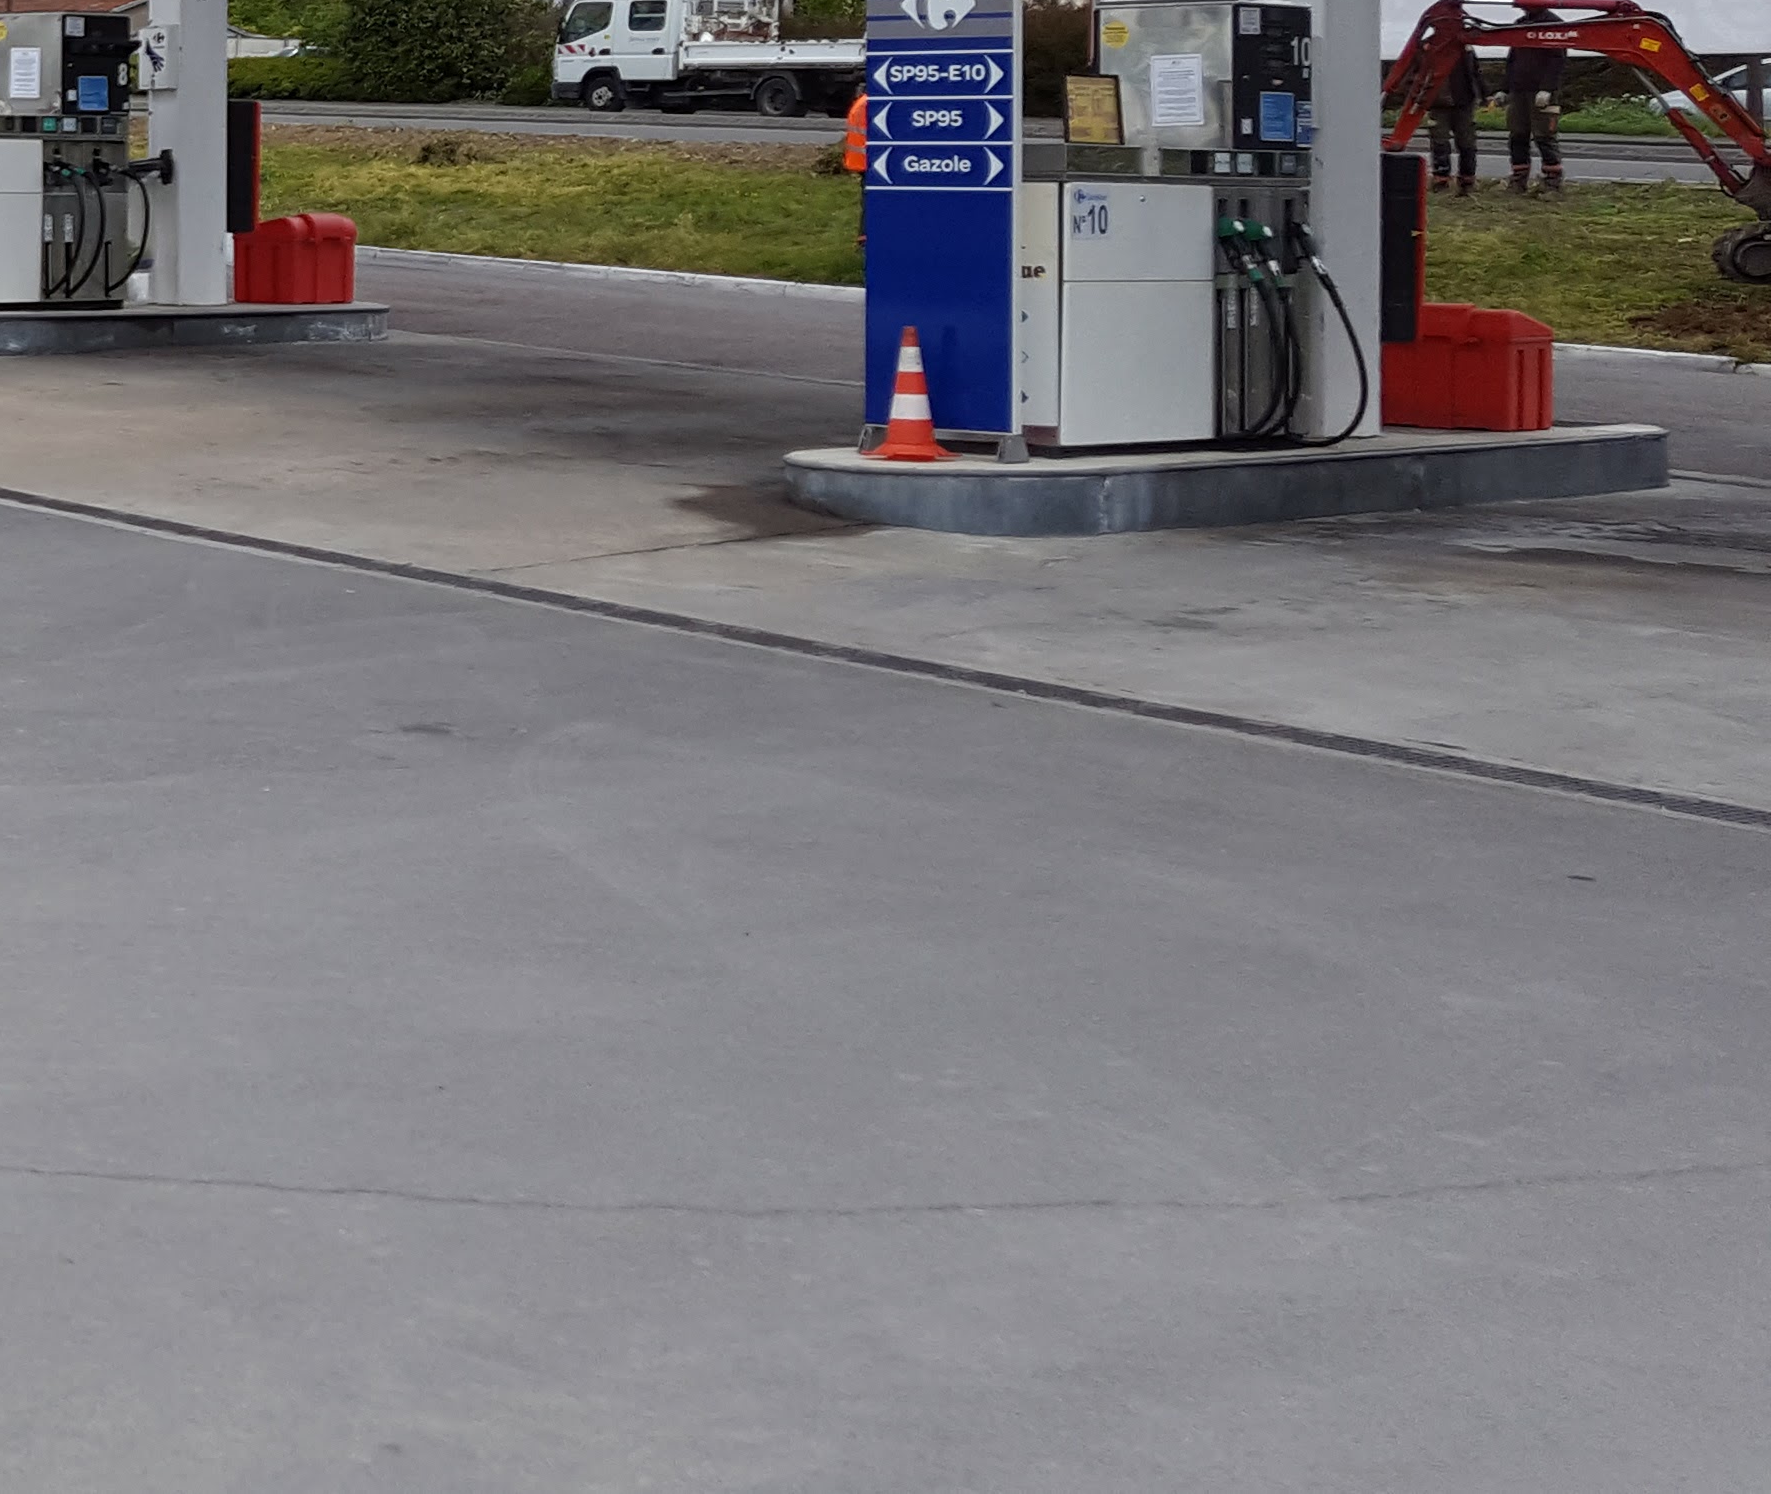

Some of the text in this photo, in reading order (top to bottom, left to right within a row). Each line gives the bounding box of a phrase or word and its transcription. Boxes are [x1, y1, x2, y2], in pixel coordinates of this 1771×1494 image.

[1291, 36, 1311, 66] 10
[117, 62, 128, 86] 8
[890, 64, 985, 82] SP95-E10
[912, 110, 962, 127] SP95
[903, 155, 971, 173] Gazole
